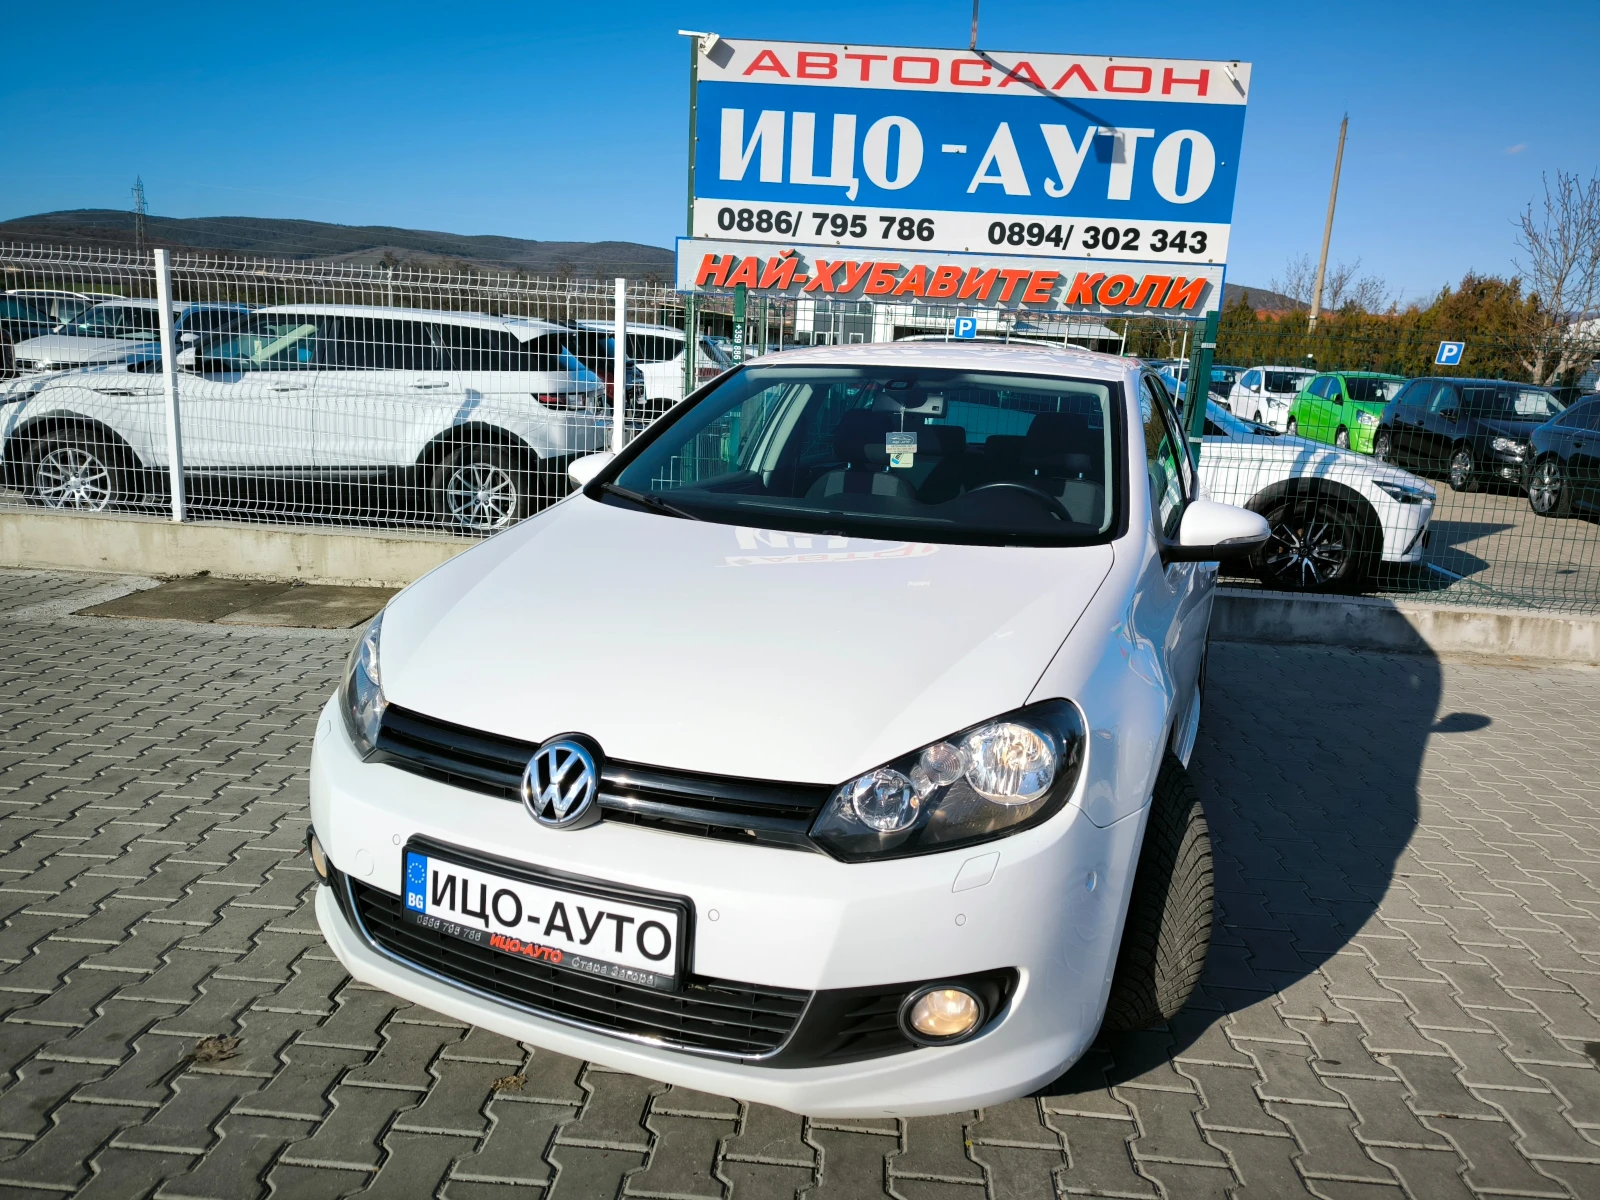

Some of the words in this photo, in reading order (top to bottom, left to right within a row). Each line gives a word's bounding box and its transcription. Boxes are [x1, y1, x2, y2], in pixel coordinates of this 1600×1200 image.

[742, 49, 1210, 96] АВТОСАЛОН
[717, 207, 802, 237] 0886/
[812, 212, 867, 238] 795
[879, 216, 935, 241] 786
[988, 221, 1074, 250] 0894/
[1082, 226, 1140, 251] 302
[1150, 229, 1208, 254] 343
[694, 248, 1060, 303] НАЙ-ХУБАВИТЕ
[1065, 272, 1208, 310] КОЛИ
[959, 319, 973, 336] P
[733, 345, 742, 360] 886
[1440, 345, 1458, 362] P
[408, 892, 424, 909] BG
[431, 870, 672, 961] ИЦО-АУТО
[489, 932, 564, 964] ИЦО-АУТО
